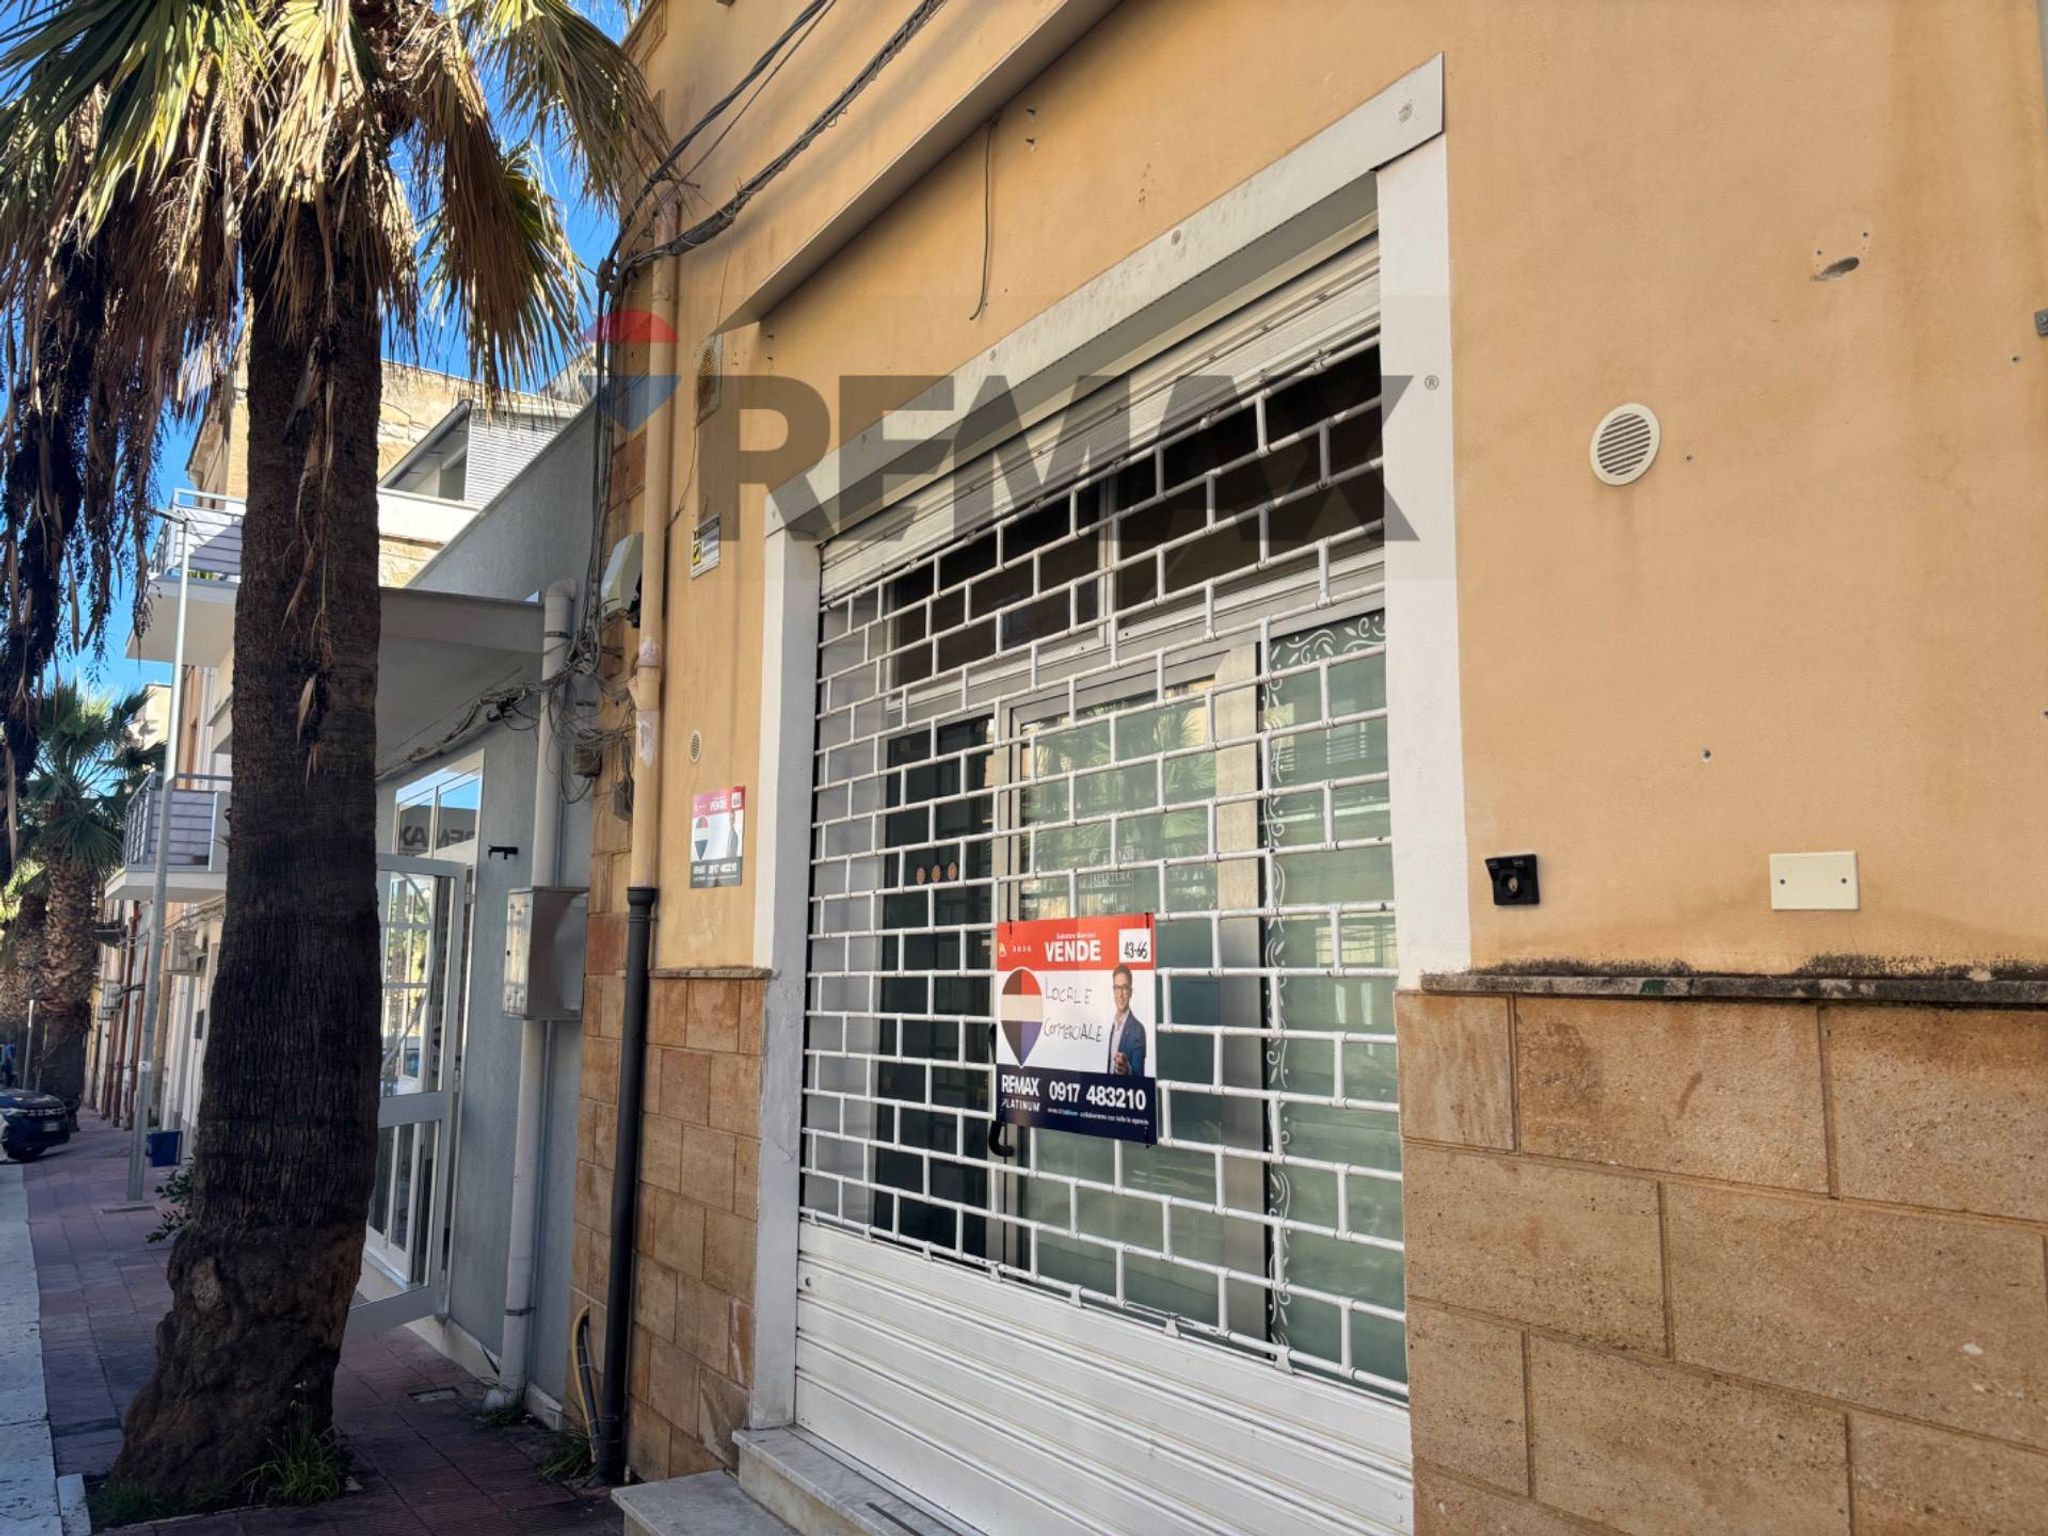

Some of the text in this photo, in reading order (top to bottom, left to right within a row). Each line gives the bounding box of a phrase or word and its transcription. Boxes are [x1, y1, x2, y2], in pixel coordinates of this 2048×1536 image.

[1045, 940, 1101, 962] VENDE
[1045, 976, 1092, 1004] LOCALE
[1001, 1074, 1040, 1097] REMAX
[1049, 1081, 1147, 1110] 0917 483210
